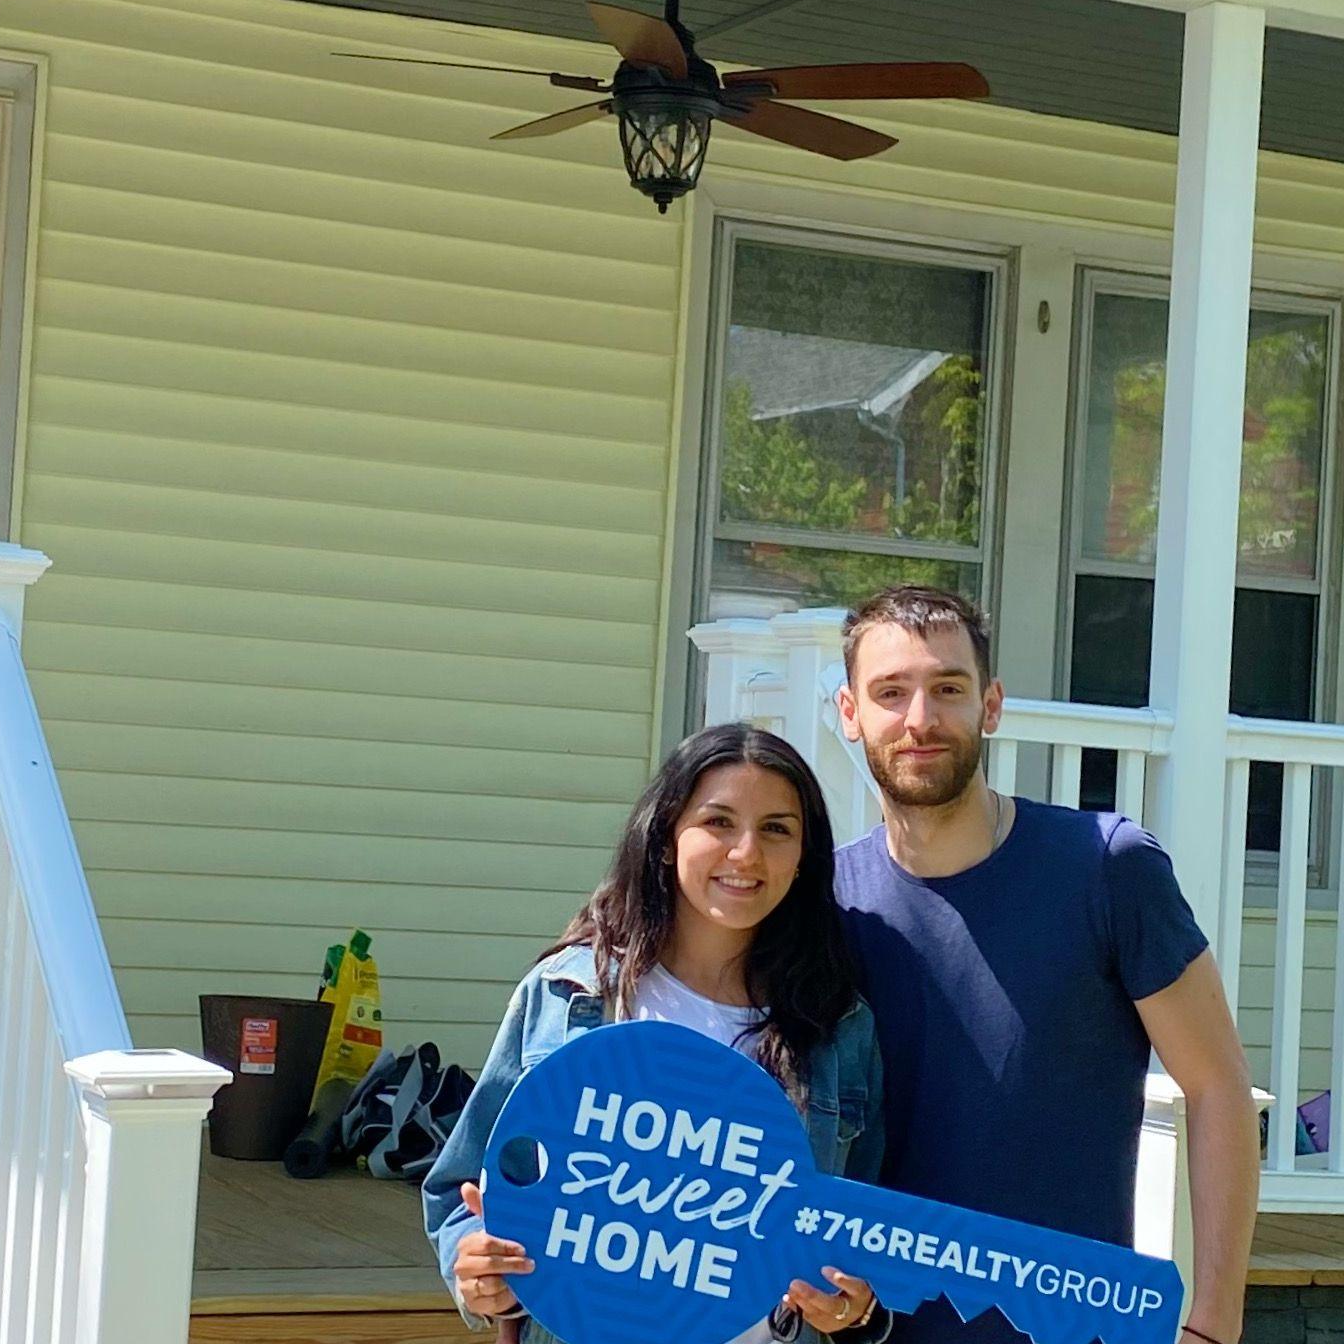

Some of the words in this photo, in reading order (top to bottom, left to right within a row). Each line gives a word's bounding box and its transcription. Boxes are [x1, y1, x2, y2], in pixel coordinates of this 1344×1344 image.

[573, 1087, 764, 1177] HOME
[561, 1151, 798, 1239] sweet
[545, 1207, 738, 1298] HOME
[795, 1207, 1163, 1317] #716REALTYGROUP
